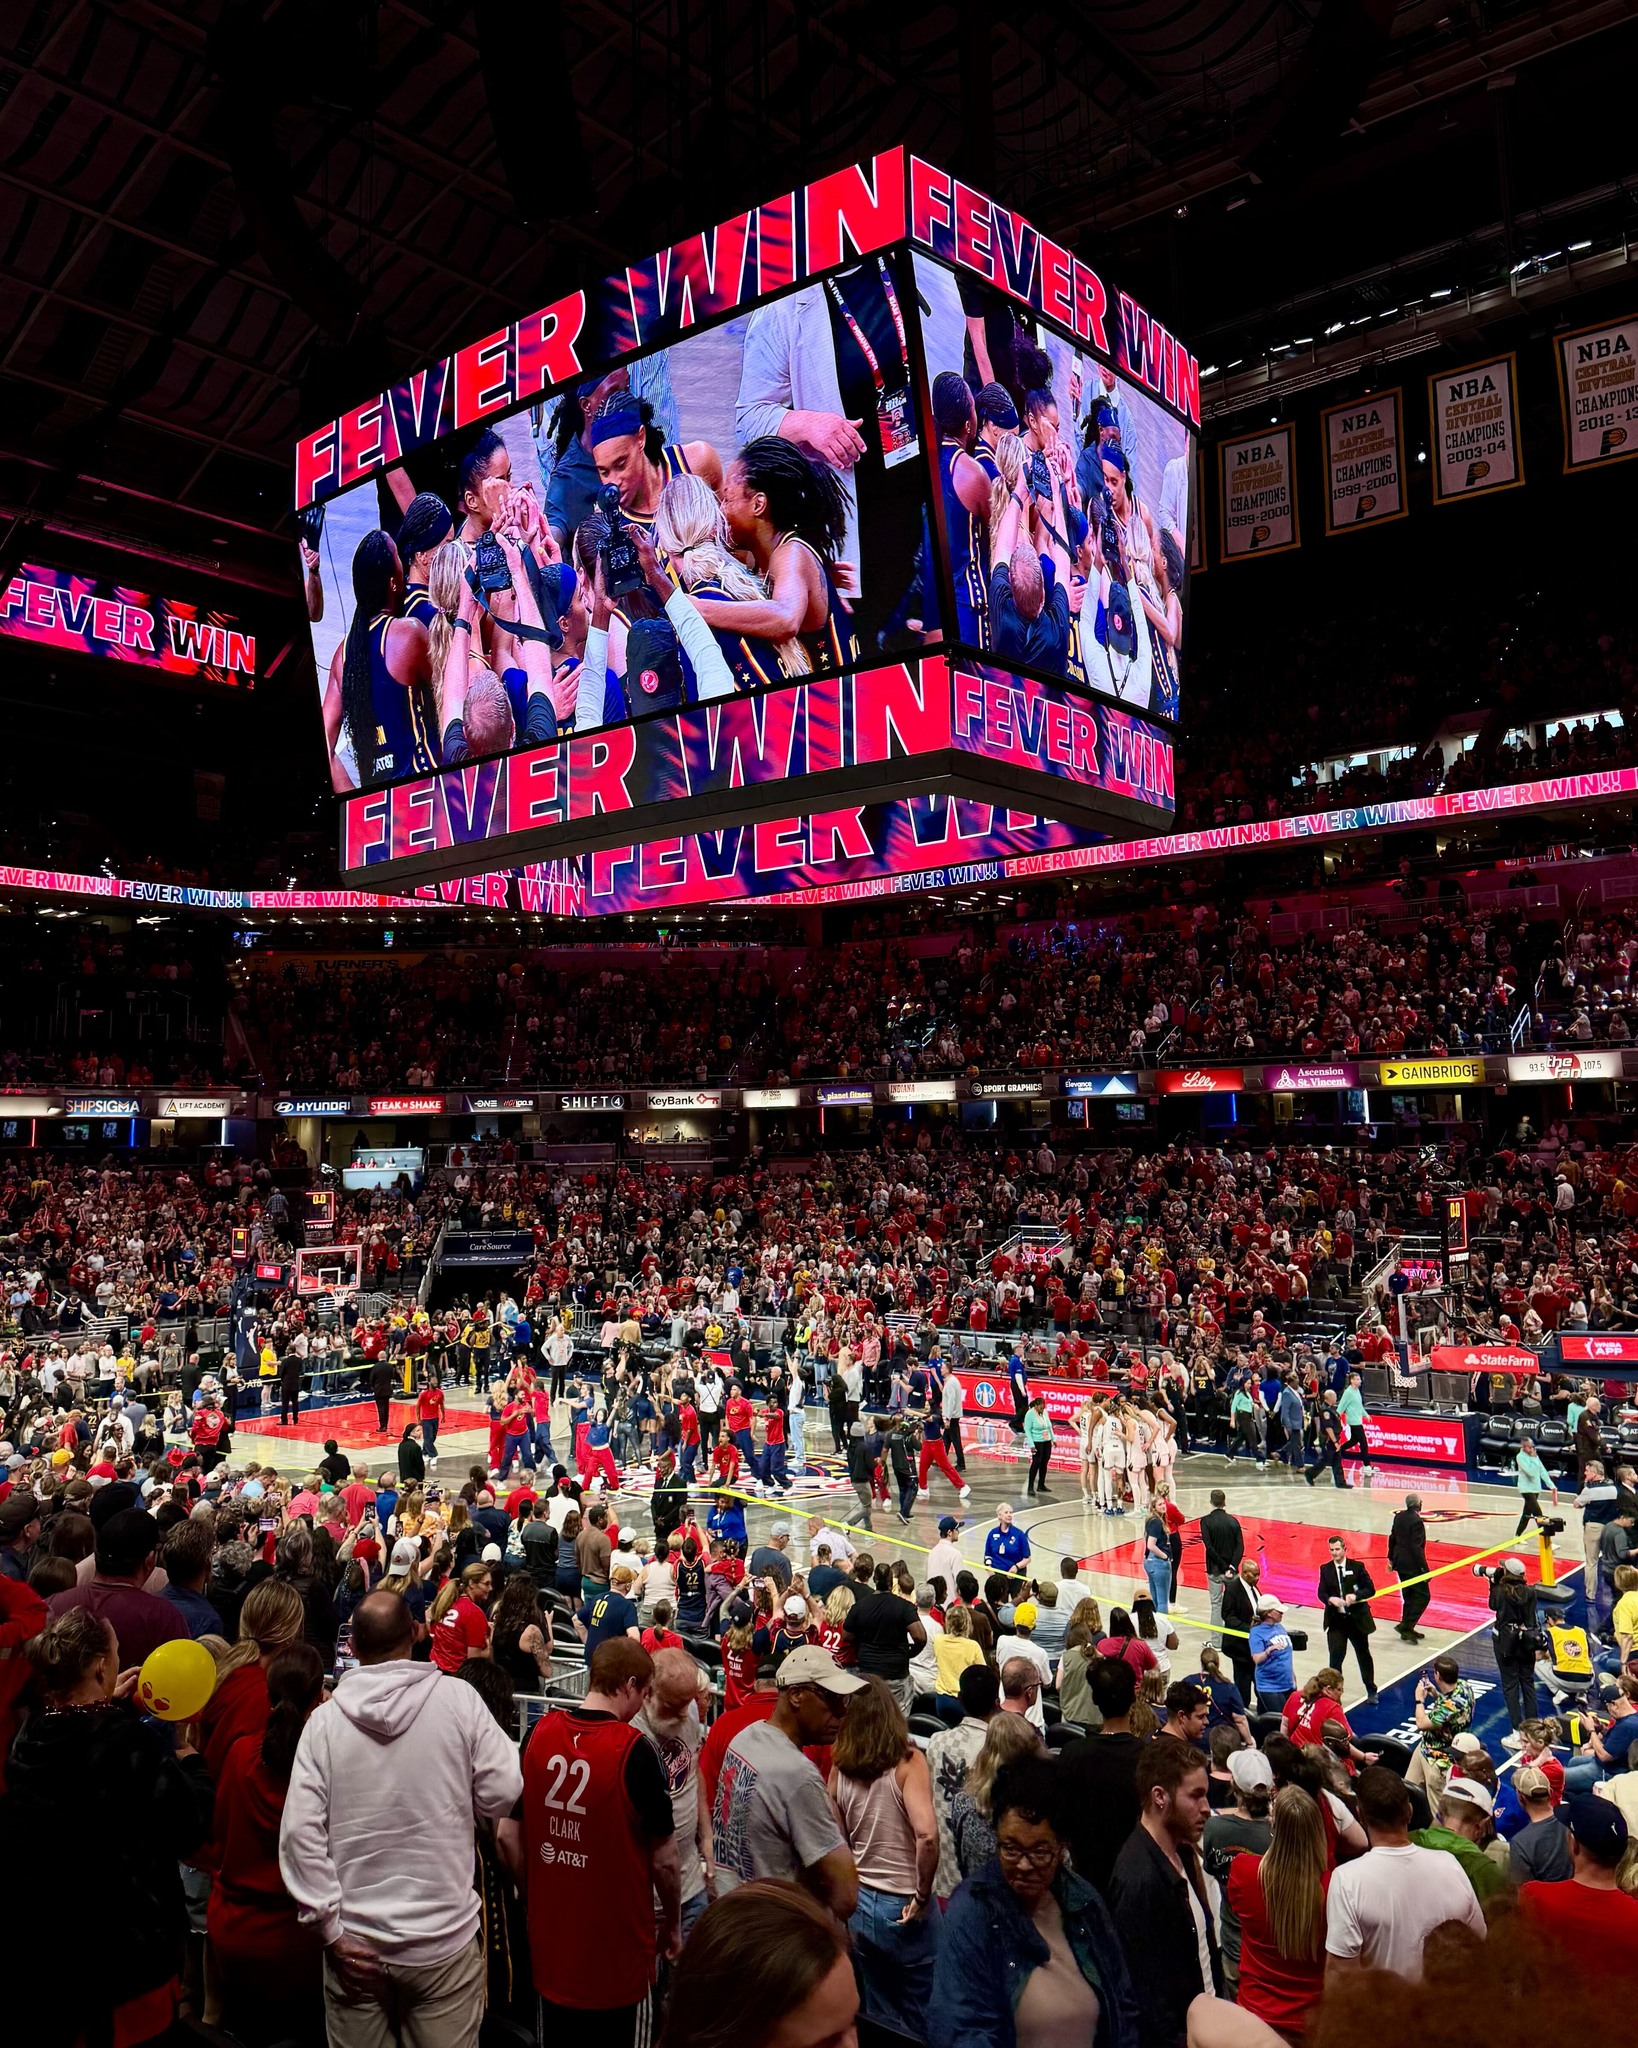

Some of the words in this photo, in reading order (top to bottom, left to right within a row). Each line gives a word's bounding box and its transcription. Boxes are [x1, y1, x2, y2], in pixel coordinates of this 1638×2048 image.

[910, 154, 1111, 355] FEVER
[1119, 291, 1202, 428] WIN
[295, 289, 586, 511] FEVER
[626, 144, 904, 347] WIN
[1577, 334, 1631, 364] NBA
[1575, 354, 1637, 381] CENTRAL
[1449, 375, 1496, 402] NBA
[1577, 368, 1636, 394] DIVISION
[1445, 393, 1502, 418] CENTRAL
[1341, 409, 1382, 434] NBA
[1446, 405, 1503, 431] DIVISION
[1445, 420, 1505, 450] CHAMPIONS
[1236, 443, 1276, 466] NBA
[1447, 440, 1506, 465] 2003-04
[1231, 460, 1283, 481] CENTRAL
[1335, 454, 1393, 484] CHAMPIONS
[1232, 471, 1283, 494] DIVISION
[1333, 472, 1397, 500] 1999-2000
[1230, 486, 1286, 513] CHAMPIONS
[1227, 504, 1290, 528] 1999-2000
[0, 577, 155, 651] FEVER
[168, 616, 256, 675] WIN
[953, 671, 1100, 775] FEVER
[1107, 721, 1176, 800] WIN
[345, 726, 637, 871] FEVER
[676, 654, 952, 795] WIN
[841, 880, 885, 898] WIN!!
[890, 869, 945, 894] FEVER
[949, 862, 998, 888] WIN!!
[1004, 851, 1065, 877] FEVER
[1070, 843, 1126, 869] WIN!!
[1132, 832, 1202, 859] FEVER
[1207, 823, 1271, 849] WIN!!
[1279, 808, 1358, 839] FEVER
[1363, 796, 1436, 826] WIN!!
[1446, 782, 1533, 815] FEVER
[1540, 770, 1622, 803] WIN!!
[55, 871, 112, 896] WIN!!
[118, 879, 182, 904] FEVER
[187, 888, 243, 909] WIN!!
[250, 891, 316, 908] FEVER
[518, 877, 586, 917] WIN
[1297, 1066, 1344, 1077] Ascension
[1401, 1064, 1480, 1080] GAINBRIDGE
[1529, 1062, 1546, 1073] 93.5
[1583, 1060, 1602, 1070] 107.5
[890, 1084, 915, 1093] INDIANA
[983, 1085, 1006, 1094] SPORT
[1007, 1083, 1043, 1092] GRAPHICS
[1065, 1078, 1093, 1088] Elevance
[1181, 1071, 1218, 1091] Lilly
[1311, 1078, 1347, 1087] Vincent
[65, 1099, 140, 1113] SHIPSIGMA
[296, 1101, 351, 1112] HYUNDAI
[370, 1101, 401, 1110] STEAK
[410, 1101, 442, 1110] SHAKE
[561, 1096, 609, 1109] SHIFT
[648, 1096, 695, 1107] KeyBank
[827, 1093, 848, 1102] planet
[849, 1090, 873, 1099] fitness
[469, 1242, 512, 1251] CareSource
[1594, 1341, 1622, 1349] WNBA
[1596, 1347, 1623, 1356] APP
[1364, 1430, 1443, 1446] OMMISSIONER'S
[1402, 1443, 1436, 1453] coinbase
[685, 1572, 699, 1586] 22
[592, 1599, 609, 1619] 10
[822, 1630, 842, 1650] 22
[544, 1754, 591, 1815] 22
[549, 1815, 581, 1842] CLARK
[557, 1850, 589, 1868] AT&T
